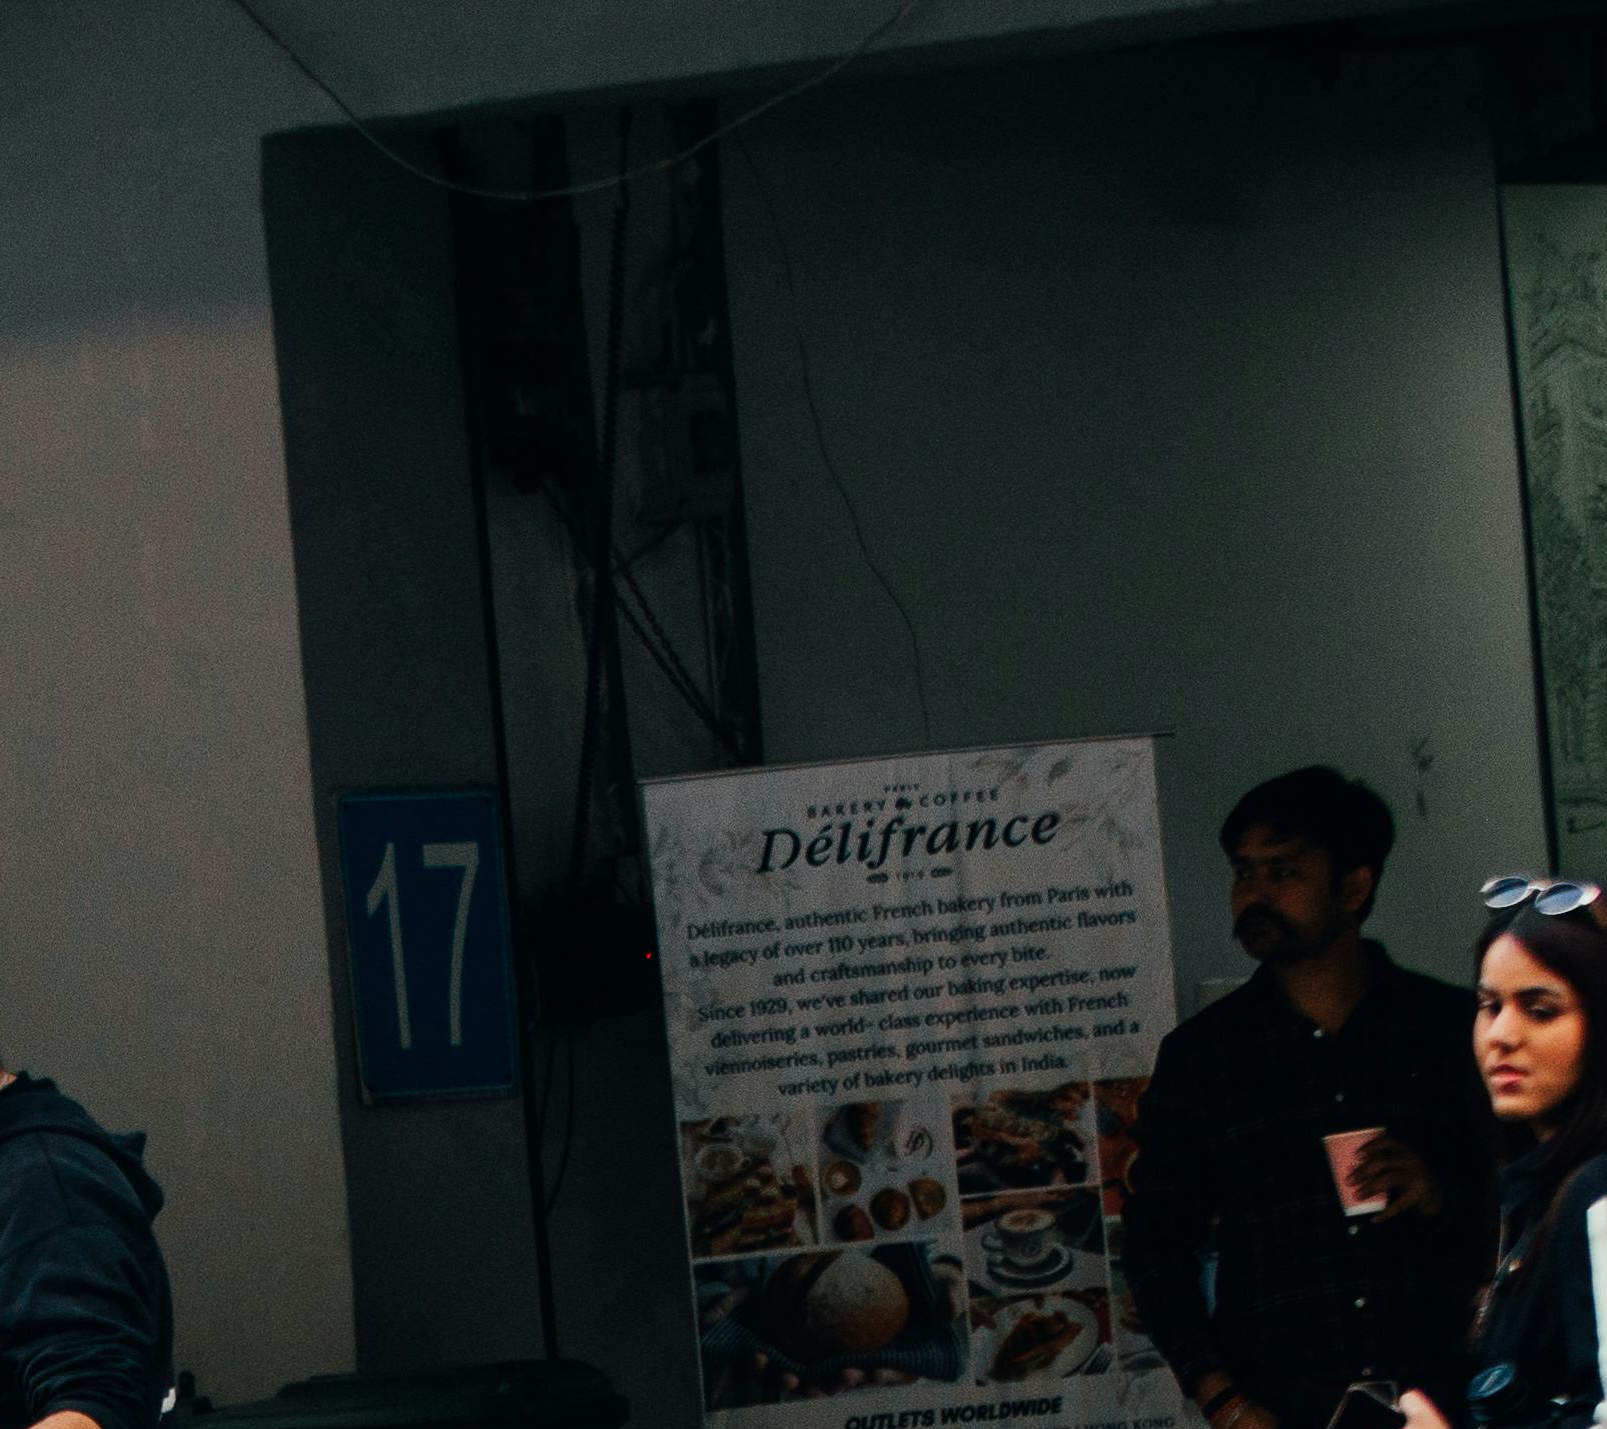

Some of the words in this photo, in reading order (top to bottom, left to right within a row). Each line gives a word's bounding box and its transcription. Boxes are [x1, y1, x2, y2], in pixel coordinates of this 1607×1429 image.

[807, 800, 886, 819] BAKERY
[920, 788, 1000, 808] COFFEE
[755, 810, 1060, 874] Délifrance
[687, 917, 780, 941] Délifrance,
[785, 909, 867, 931] authentic
[873, 902, 932, 921] French
[937, 895, 997, 915] bakery
[1001, 891, 1042, 908] from
[1047, 885, 1090, 904] Paris
[1094, 880, 1134, 898] with
[365, 841, 481, 1050] 17
[690, 956, 700, 972] a
[704, 949, 758, 970] legacy
[762, 942, 781, 960] of
[784, 942, 823, 959] over
[827, 935, 853, 954] 110
[857, 933, 910, 955] years,
[912, 924, 986, 946] bringing
[990, 915, 1072, 938] authentic
[1077, 910, 1137, 929] flavors
[773, 968, 806, 986] and
[810, 957, 933, 982] craftsmanship
[938, 956, 957, 970] to
[960, 951, 1008, 969] every
[1011, 946, 1049, 963] bite.
[697, 1003, 746, 1023] Since
[796, 992, 847, 1011] we've
[850, 985, 909, 1006] shared
[913, 983, 942, 1000] our
[947, 975, 1006, 996] baking
[1009, 969, 1095, 991] expertise,
[1098, 965, 1137, 982] now
[710, 1026, 797, 1050] delivering
[800, 1027, 810, 1039] a
[814, 1017, 873, 1037] world-
[878, 1014, 920, 1032] class
[925, 1005, 1020, 1029] experience
[1024, 999, 1063, 1016] with
[1067, 992, 1129, 1012] French
[704, 1051, 823, 1077] viennoiseries,
[827, 1042, 900, 1068] pastries,
[906, 1035, 980, 1060] gourmet
[982, 1025, 1089, 1047] sandwiches,
[1093, 1020, 1125, 1039] and
[1129, 1020, 1140, 1034] a
[777, 1076, 839, 1097] variety
[842, 1072, 861, 1090] of
[864, 1070, 924, 1089] bakery
[927, 1061, 996, 1083] delights
[999, 1056, 1017, 1074] in
[1021, 1053, 1068, 1073] India.
[941, 1396, 1063, 1425] WORLDWIDE
